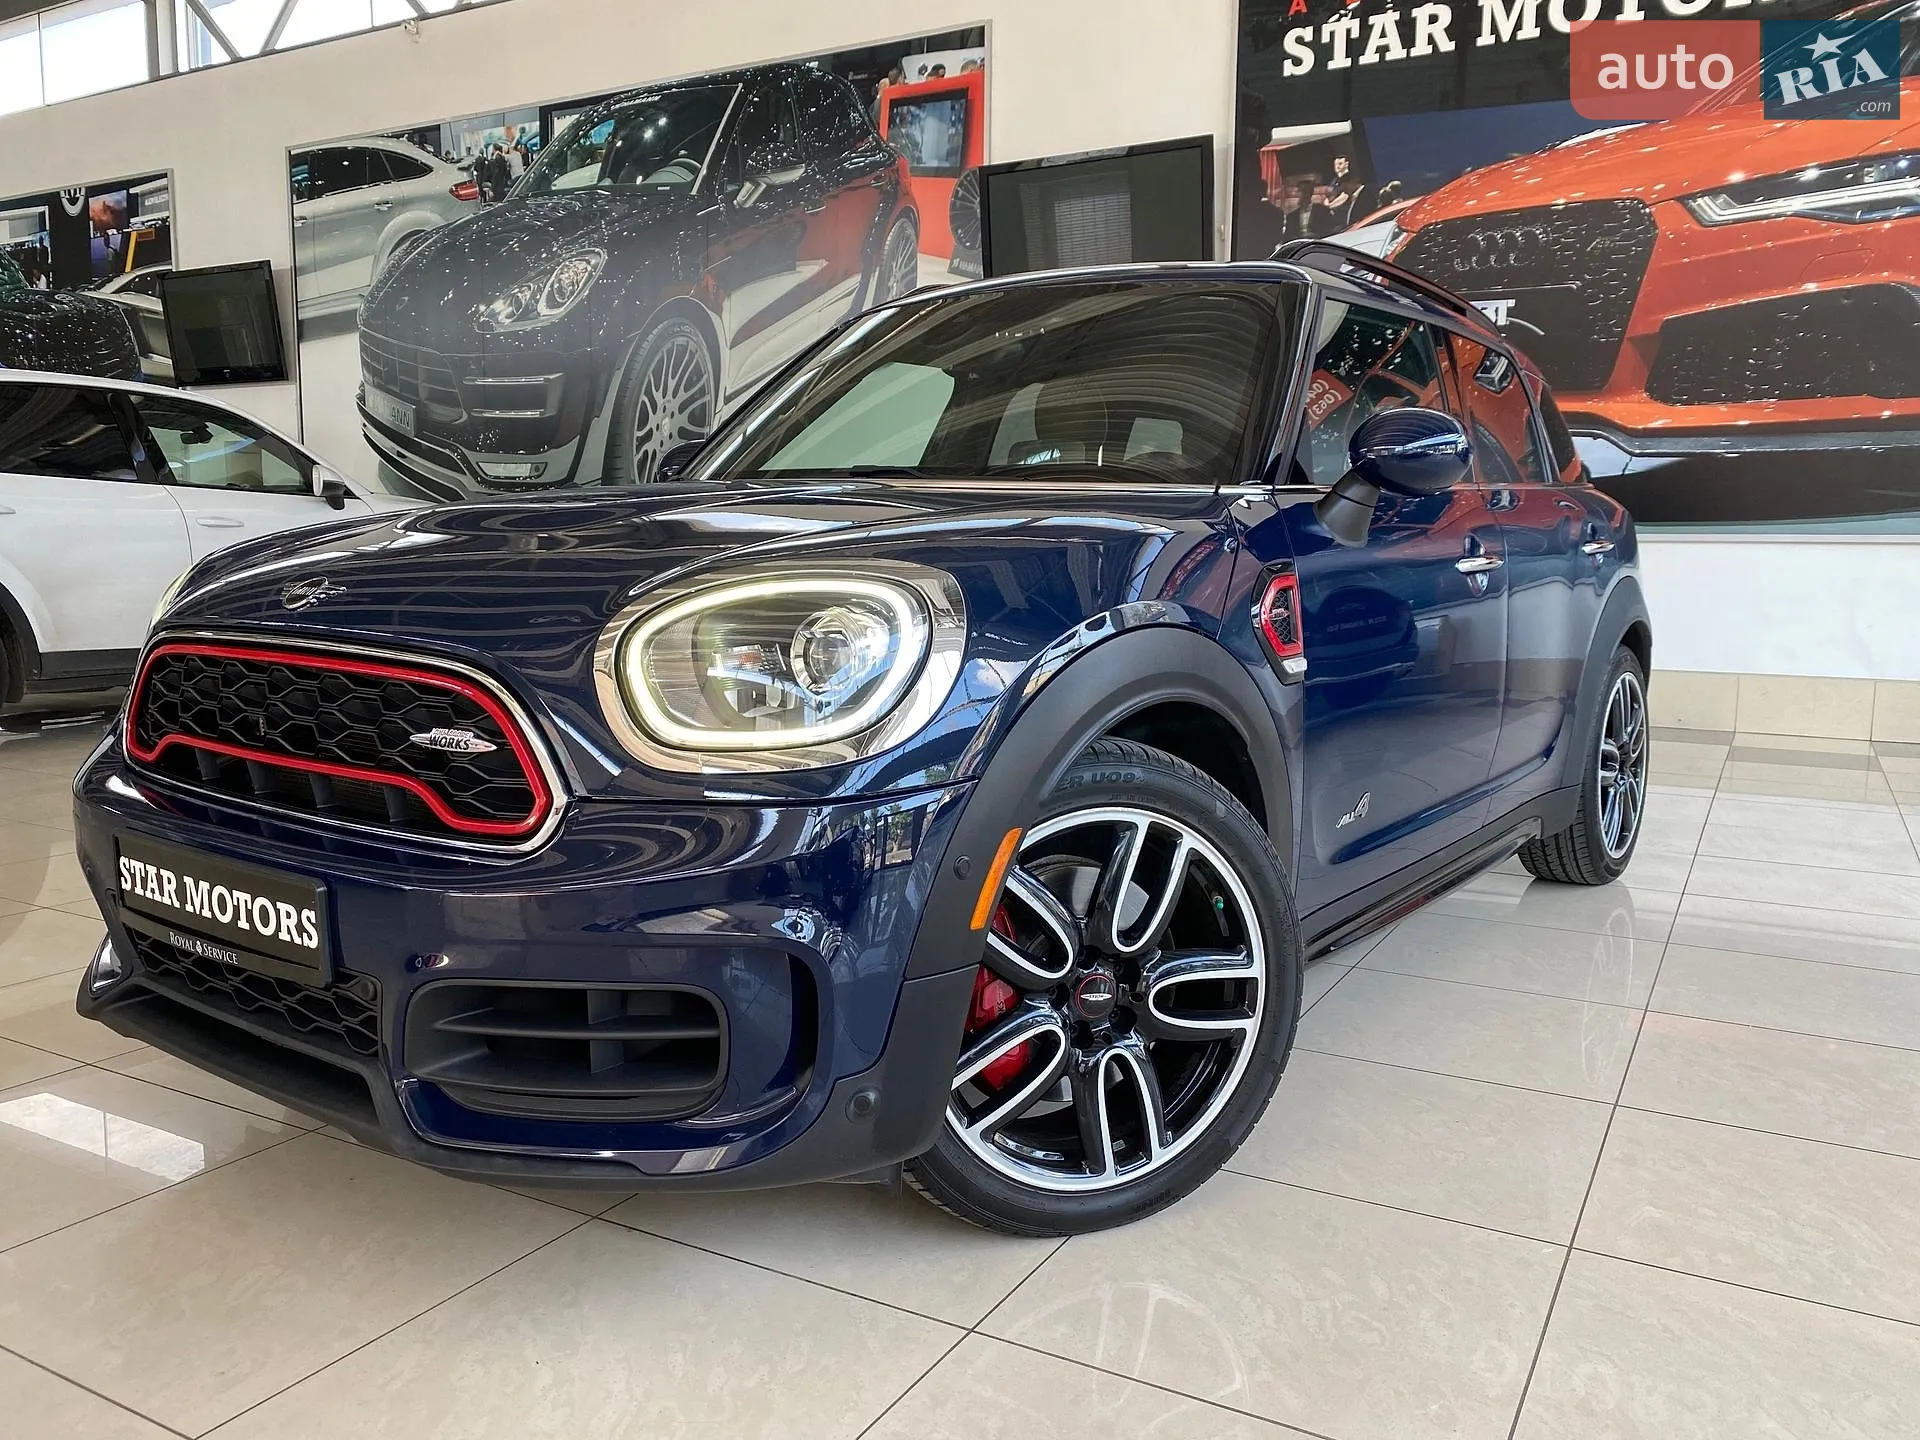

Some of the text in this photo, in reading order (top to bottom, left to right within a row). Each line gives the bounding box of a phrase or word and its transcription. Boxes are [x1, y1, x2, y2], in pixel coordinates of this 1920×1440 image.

[1283, 3, 1456, 77] STAR
[429, 734, 471, 751] WORKS
[119, 855, 319, 949] STAR MOTORS
[169, 931, 239, 965] ROYAL SERVICE
